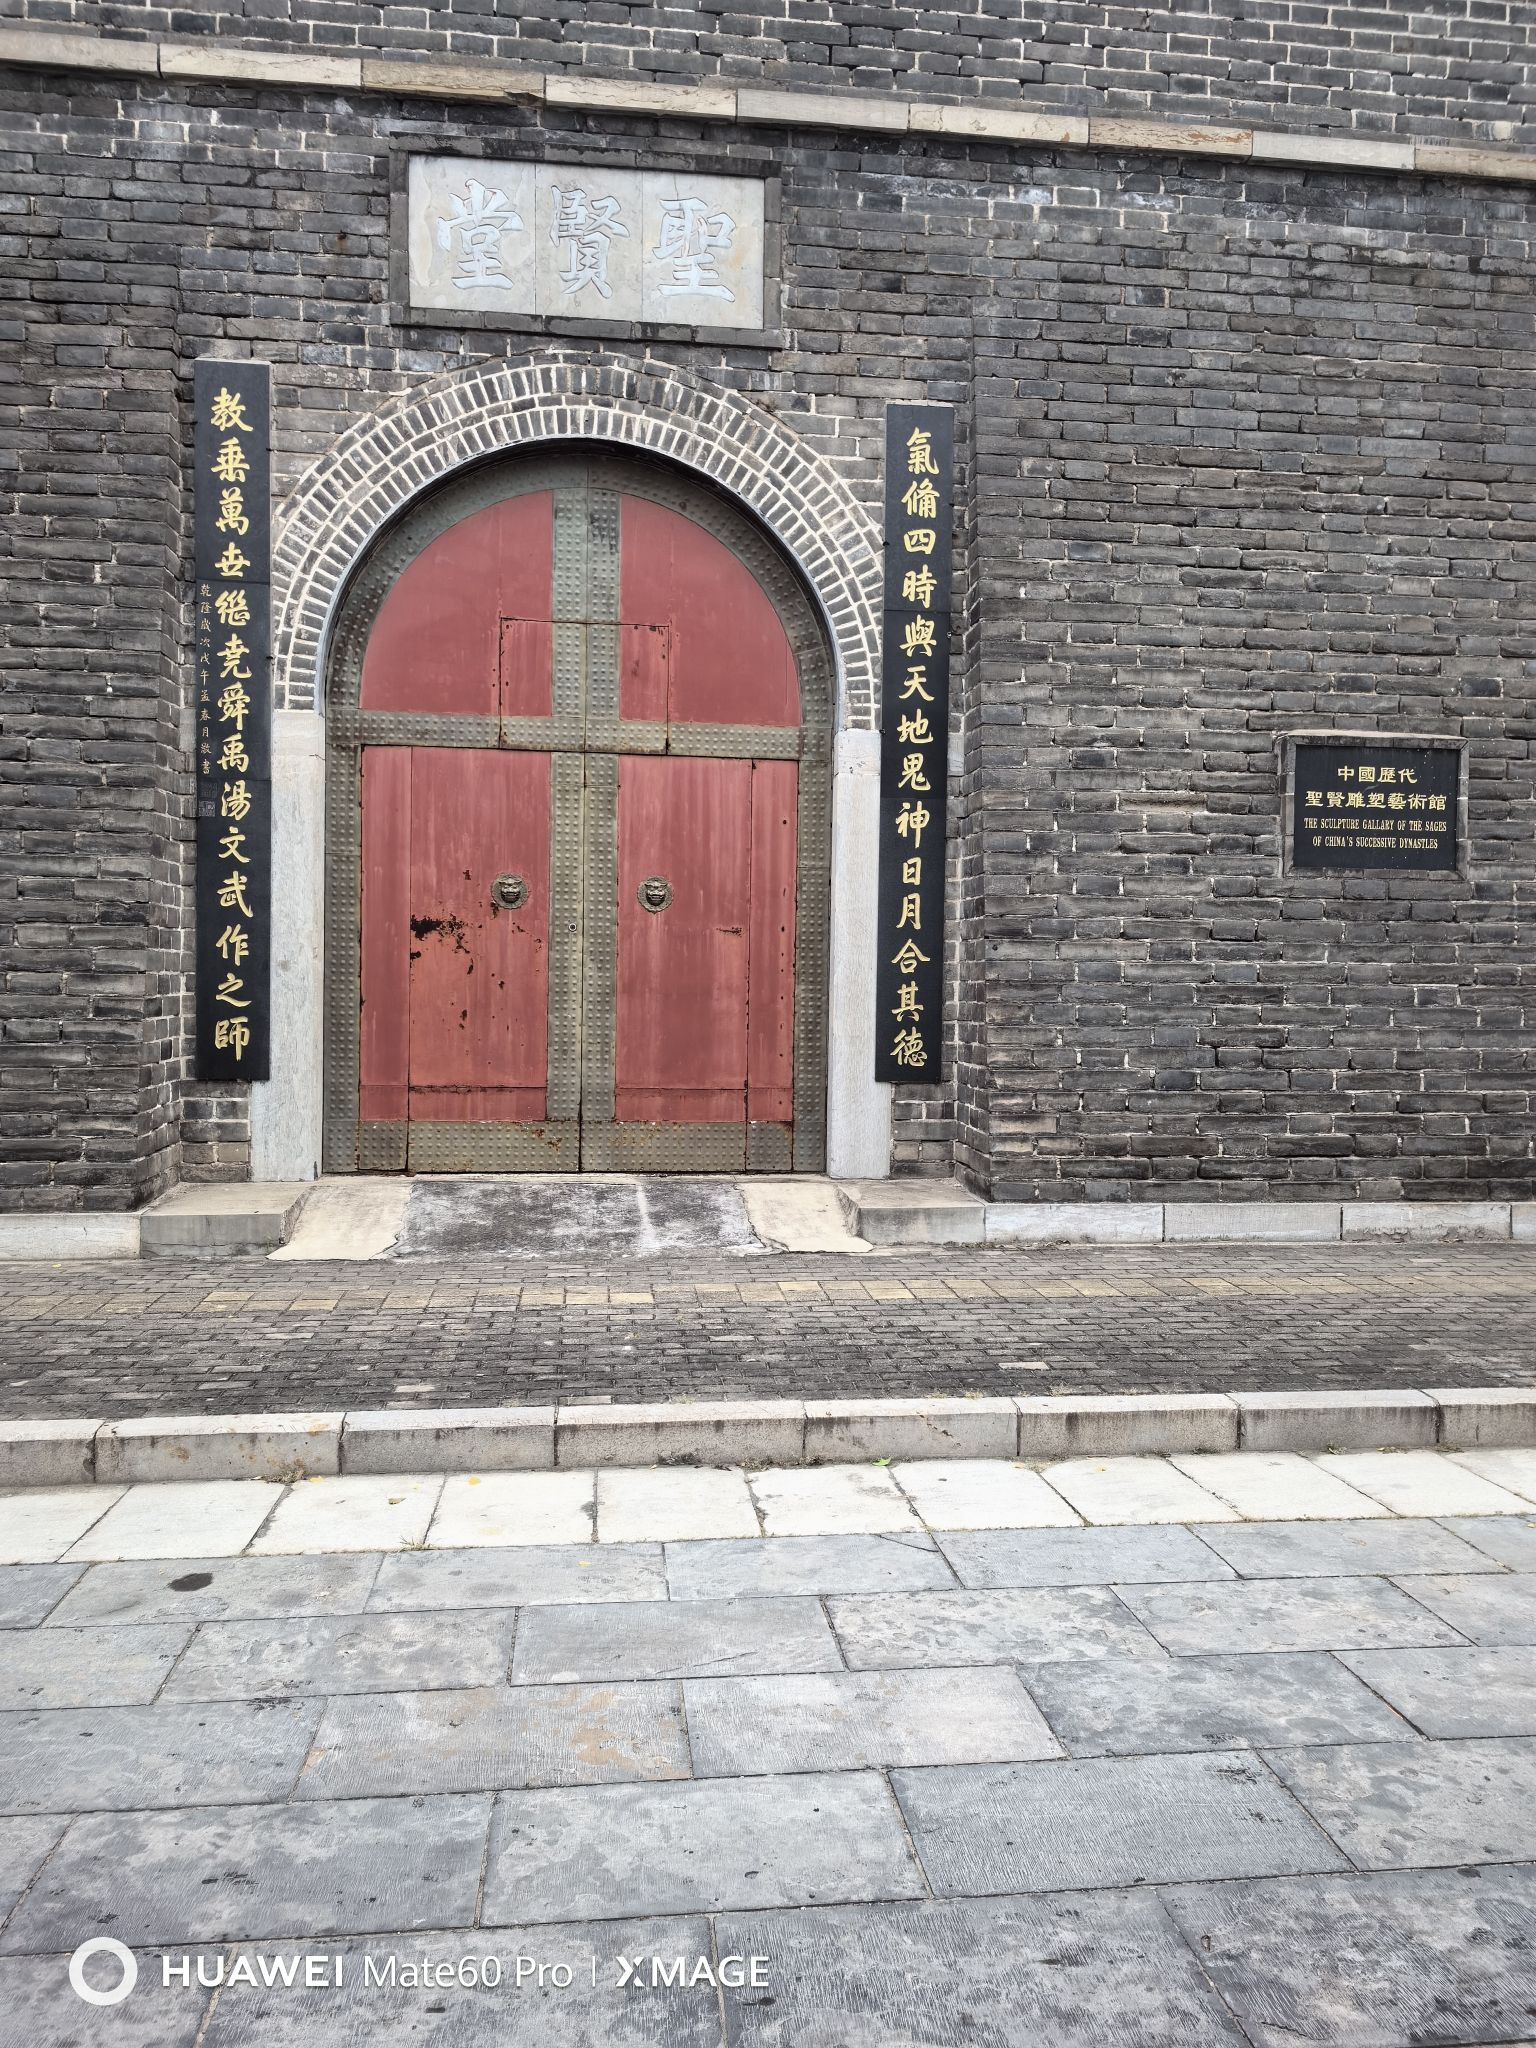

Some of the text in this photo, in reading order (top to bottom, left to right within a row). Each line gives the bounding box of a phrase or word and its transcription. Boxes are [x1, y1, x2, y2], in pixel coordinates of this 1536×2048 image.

[1304, 790, 1447, 811] 聖賢雕塑藝術館
[1304, 817, 1318, 829] THE
[1320, 818, 1360, 830] SCULPTURE
[1397, 820, 1406, 831] OF
[1409, 820, 1423, 831] THE
[1425, 820, 1447, 832] SAGES
[1312, 836, 1322, 846] OF
[1324, 836, 1353, 847] CHINA'S
[1356, 837, 1396, 848] SUCCESSIVE
